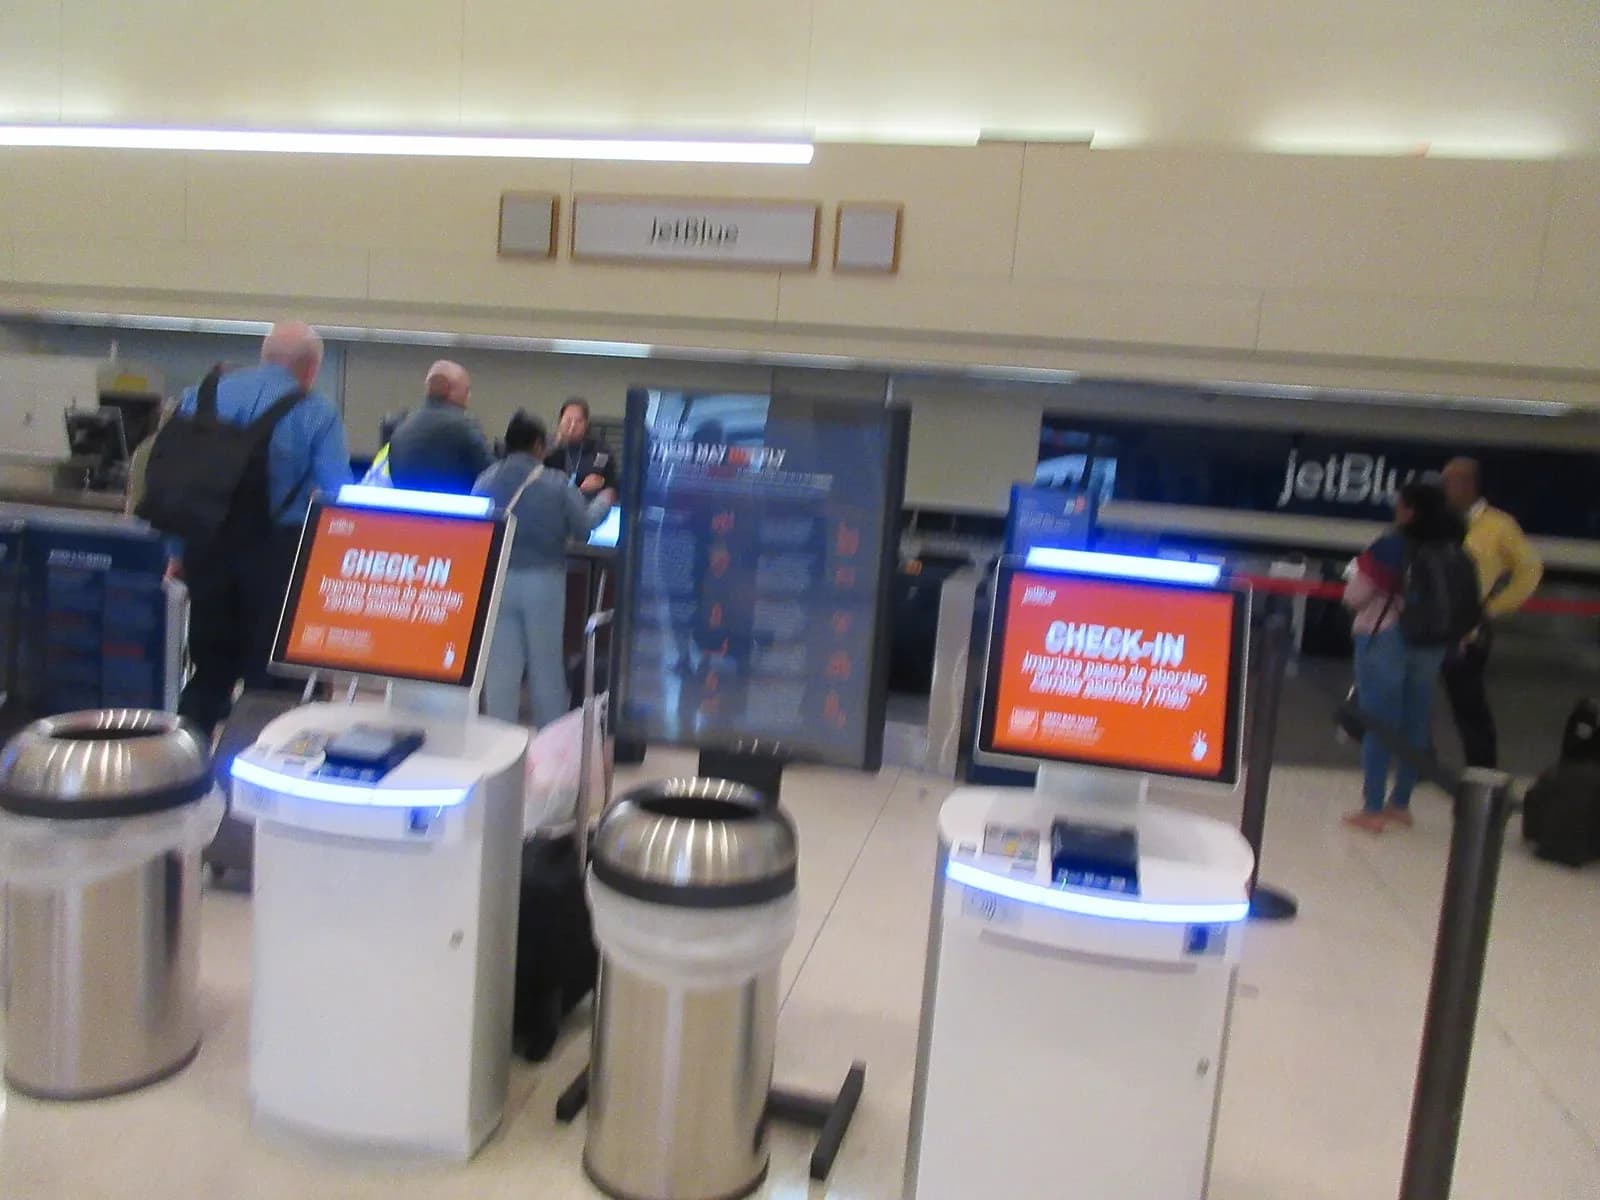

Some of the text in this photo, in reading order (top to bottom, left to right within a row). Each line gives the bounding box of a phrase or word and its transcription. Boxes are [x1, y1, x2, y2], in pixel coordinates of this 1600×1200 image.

[340, 548, 451, 588] CHECK-IN
[1046, 620, 1185, 667] CHECK-IN
[1128, 663, 1147, 685] de
